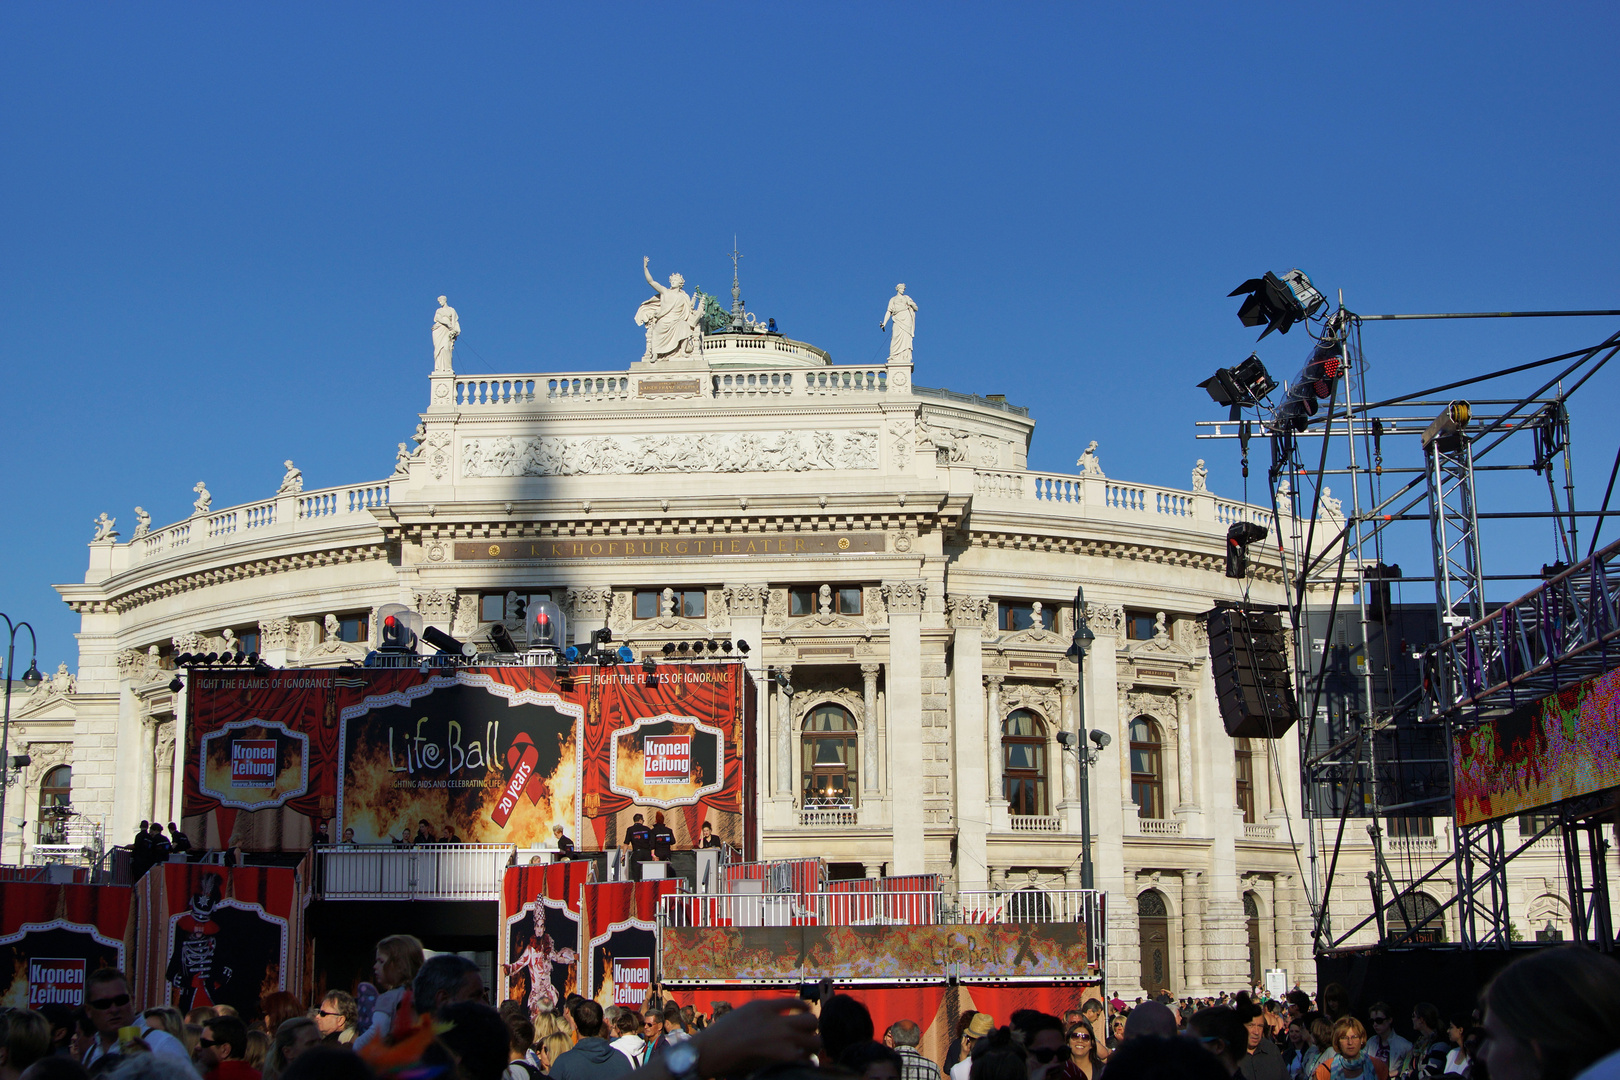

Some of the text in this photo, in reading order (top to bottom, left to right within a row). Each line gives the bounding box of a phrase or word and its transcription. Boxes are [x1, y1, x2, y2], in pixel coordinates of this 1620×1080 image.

[196, 678, 332, 689] FIGHT THE FLAMES OF IGNORANCE
[594, 674, 617, 685] FIGHT
[619, 674, 635, 684] THE
[671, 673, 682, 683] OF
[684, 672, 733, 683] IGNORANCE
[233, 744, 275, 759] Kronen
[388, 716, 504, 774] Life Ball
[646, 740, 689, 756] Kronen
[233, 760, 275, 777] Zeitung
[645, 756, 689, 773] Zeitung
[417, 780, 432, 788] AIDS
[432, 780, 447, 788] AND
[447, 780, 488, 788] CELEBRATING
[489, 779, 501, 788] LIFE
[499, 761, 531, 815] 20 years
[31, 964, 84, 983] Kronen
[615, 964, 649, 983] Kronen
[30, 984, 83, 1006] Zeitung
